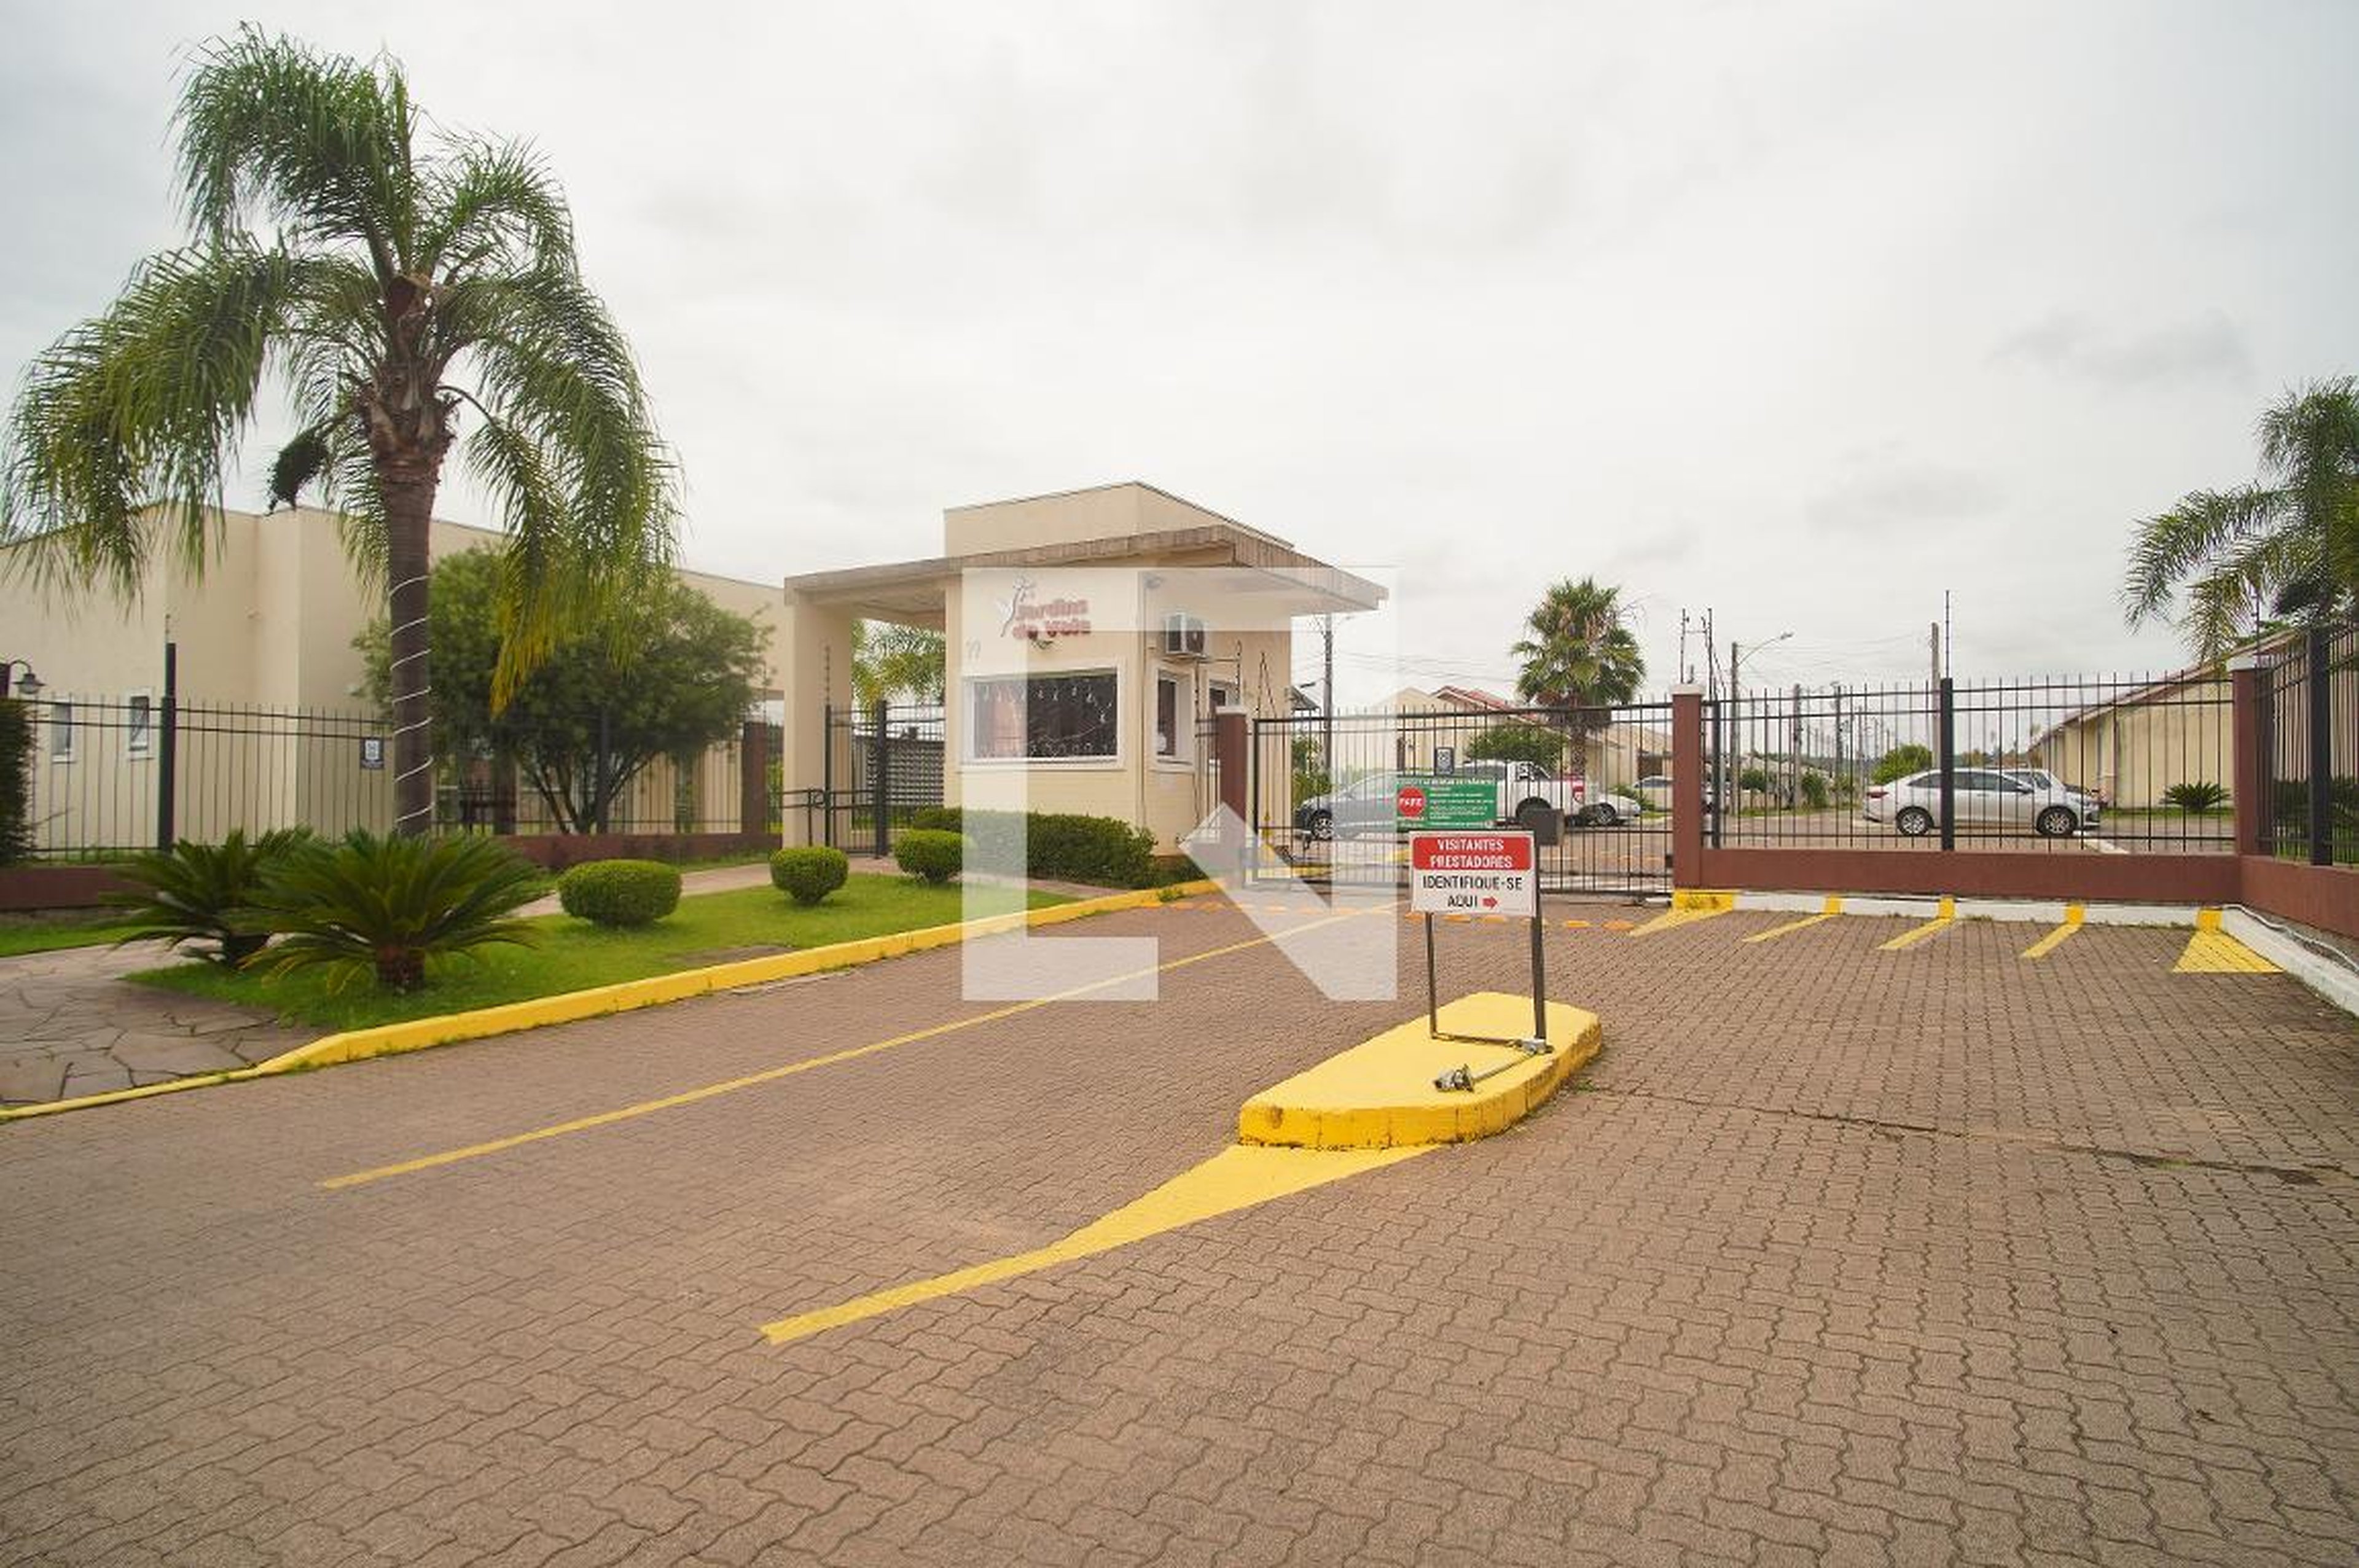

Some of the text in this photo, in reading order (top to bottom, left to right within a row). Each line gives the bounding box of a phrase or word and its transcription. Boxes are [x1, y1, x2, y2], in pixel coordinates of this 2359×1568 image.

[1437, 839, 1504, 851] VISITANTES
[1430, 855, 1513, 868] PRESTADORES
[1423, 876, 1522, 891] IDENTIFIQUE-SE
[1447, 895, 1477, 908] AQUI
